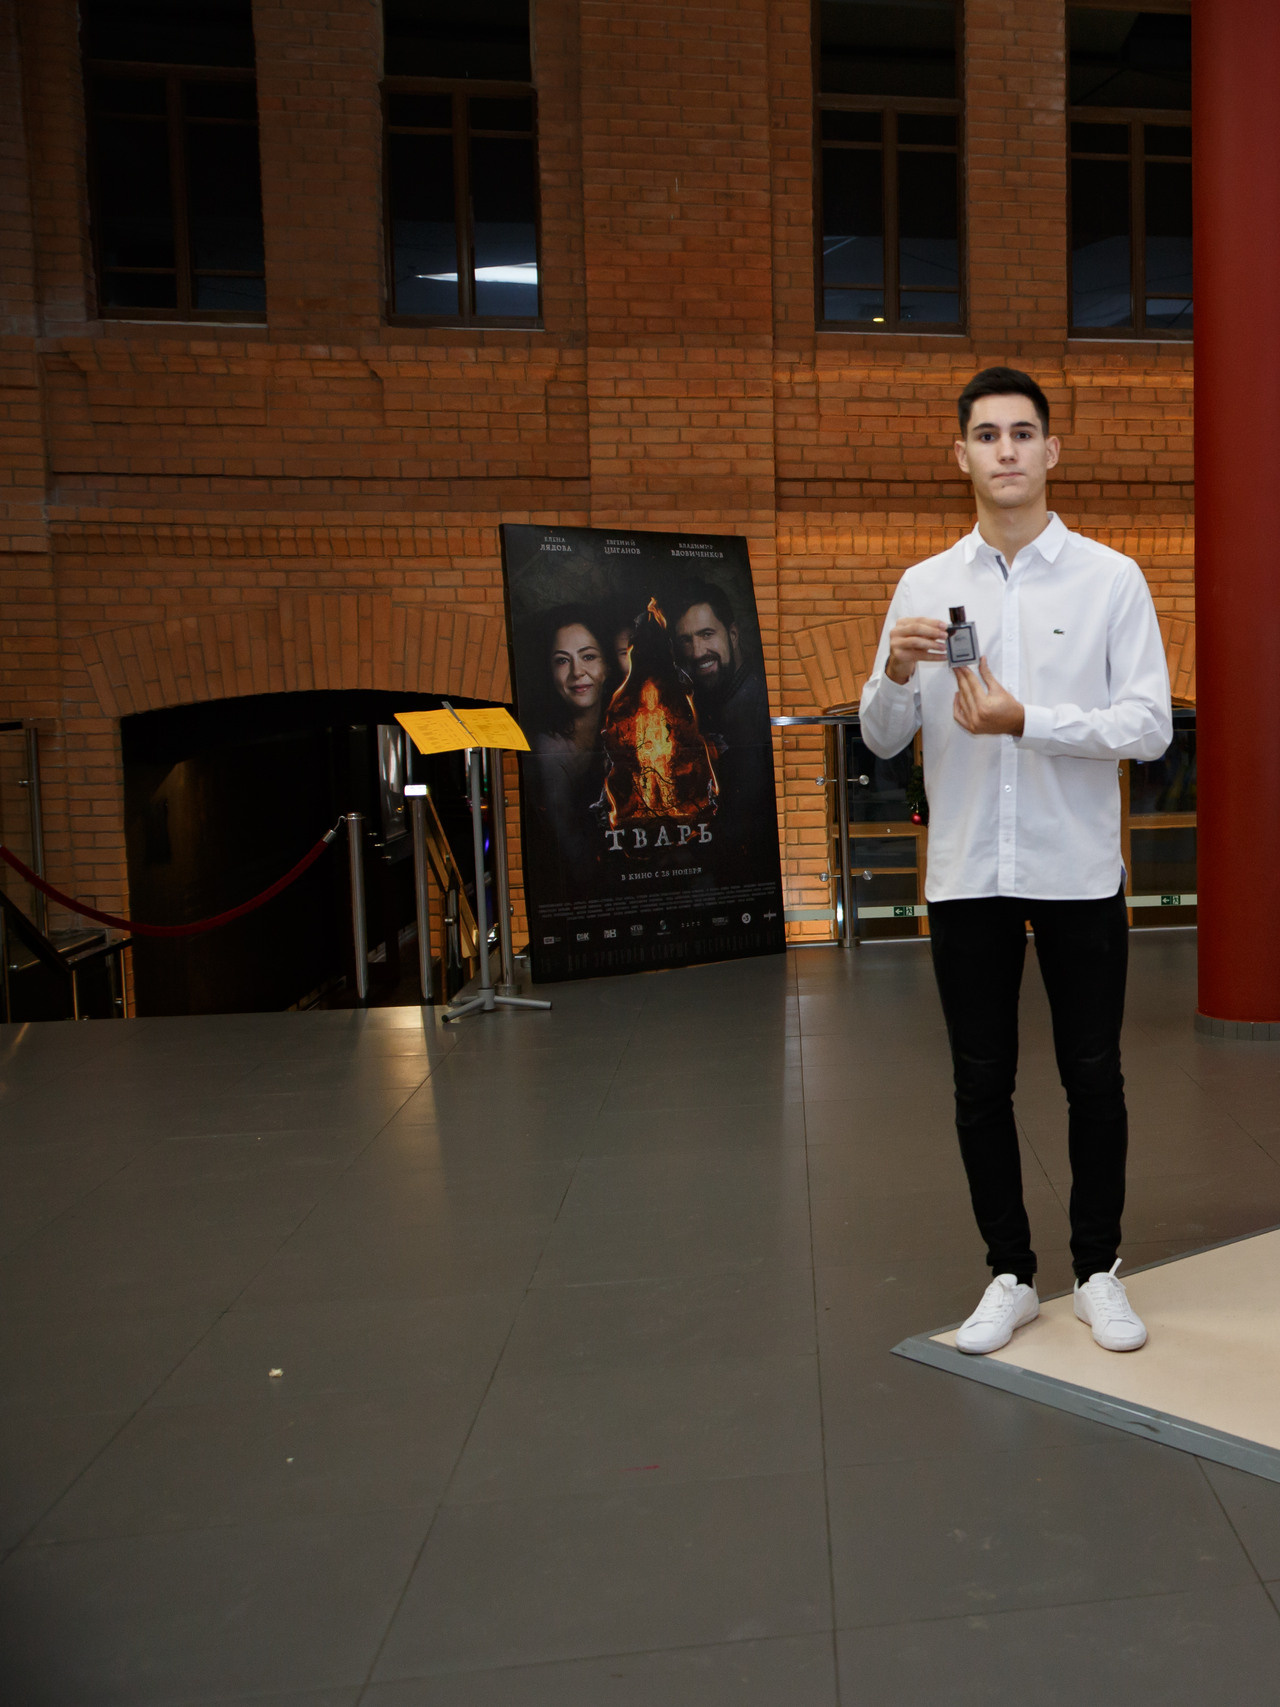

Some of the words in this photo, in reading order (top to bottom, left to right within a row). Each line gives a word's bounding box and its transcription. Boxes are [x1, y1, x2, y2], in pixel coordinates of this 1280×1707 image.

[539, 544, 573, 552] ЛЯДОВА
[604, 547, 641, 555] ЦЫГАНОВ
[670, 549, 725, 558] ВДОВИЧЕНКОВ
[604, 823, 713, 851] ТВАРЬ
[628, 872, 653, 881] КИНО
[672, 867, 703, 876] НОЯБРЯ
